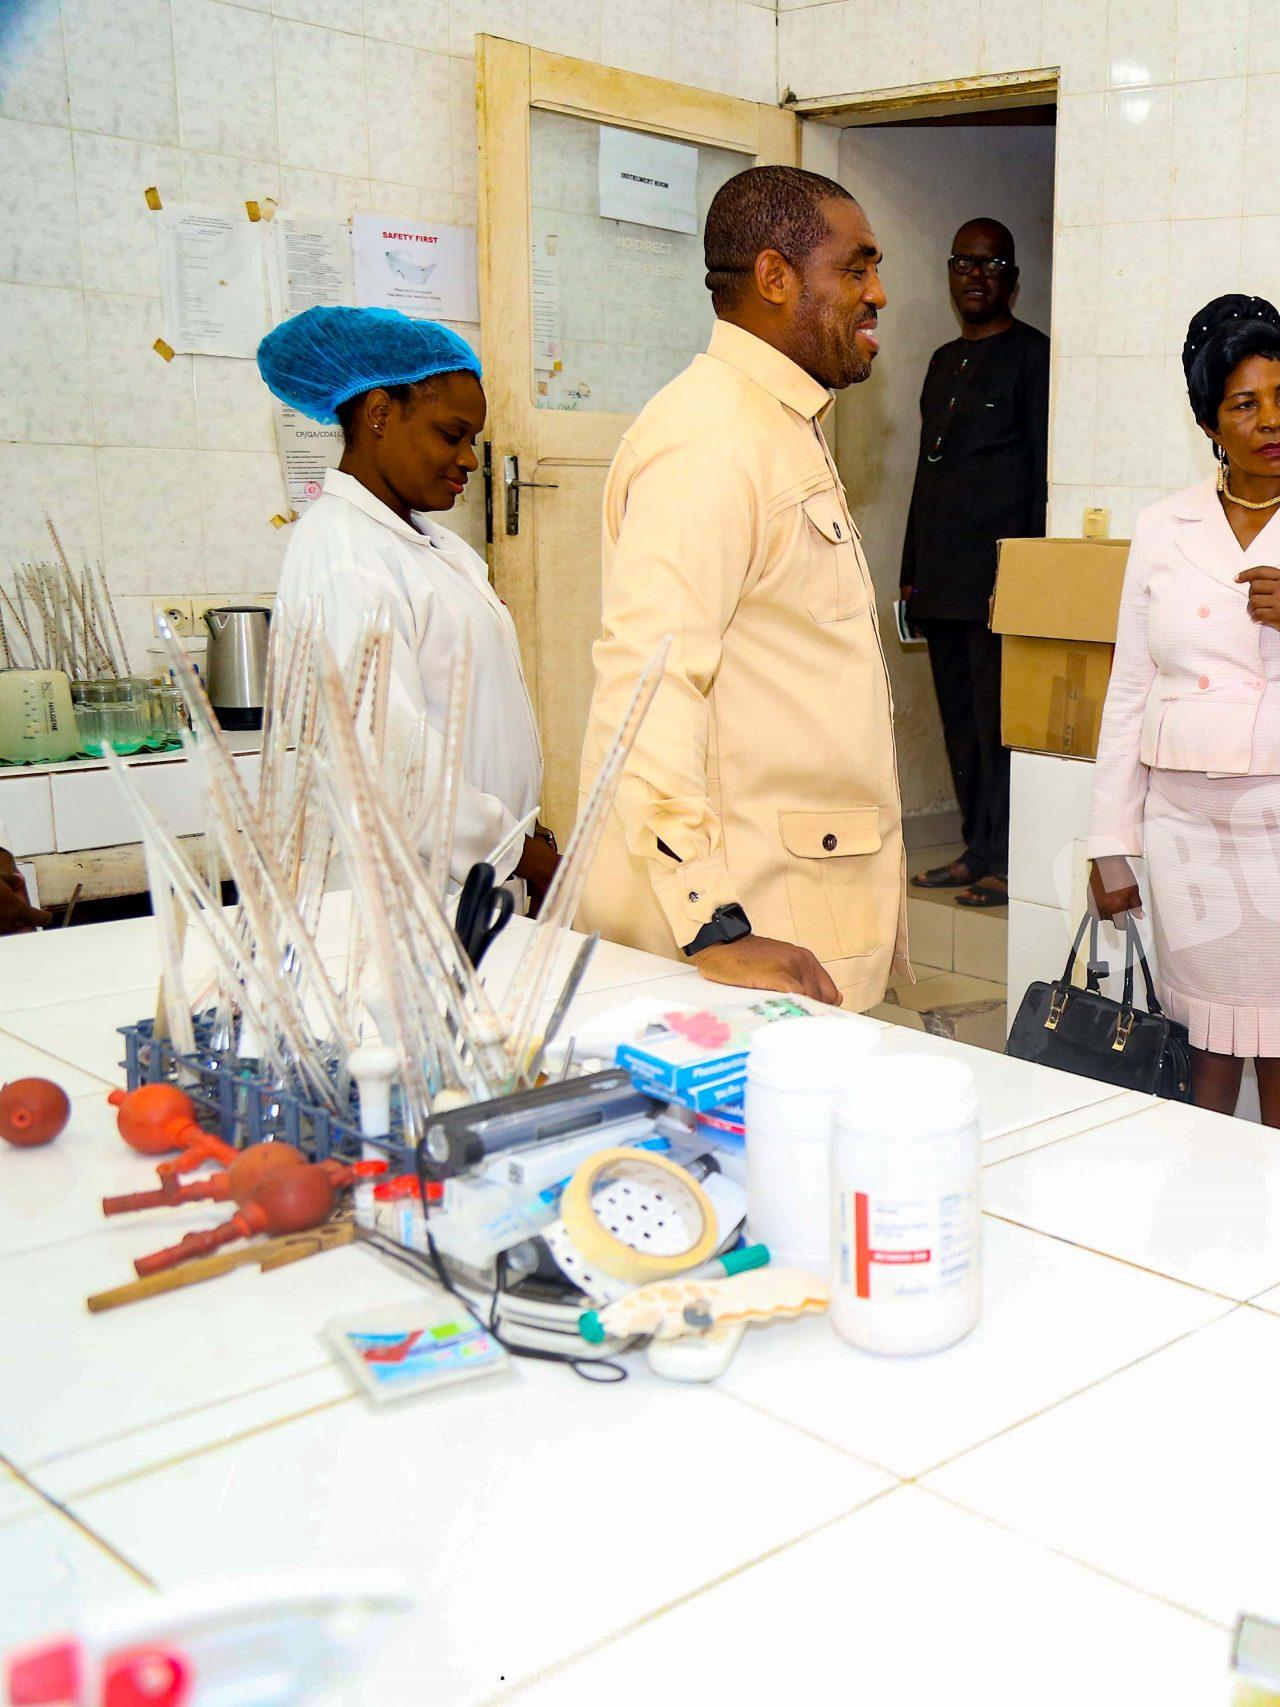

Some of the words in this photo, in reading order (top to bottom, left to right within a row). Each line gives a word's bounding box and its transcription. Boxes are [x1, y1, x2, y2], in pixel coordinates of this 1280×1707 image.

[619, 172, 653, 184] INSTRUMENT
[653, 180, 669, 188] ROOM
[382, 231, 414, 241] SAFETY
[415, 235, 438, 243] FIRST
[617, 237, 631, 249] NO
[632, 239, 672, 255] DIRECT
